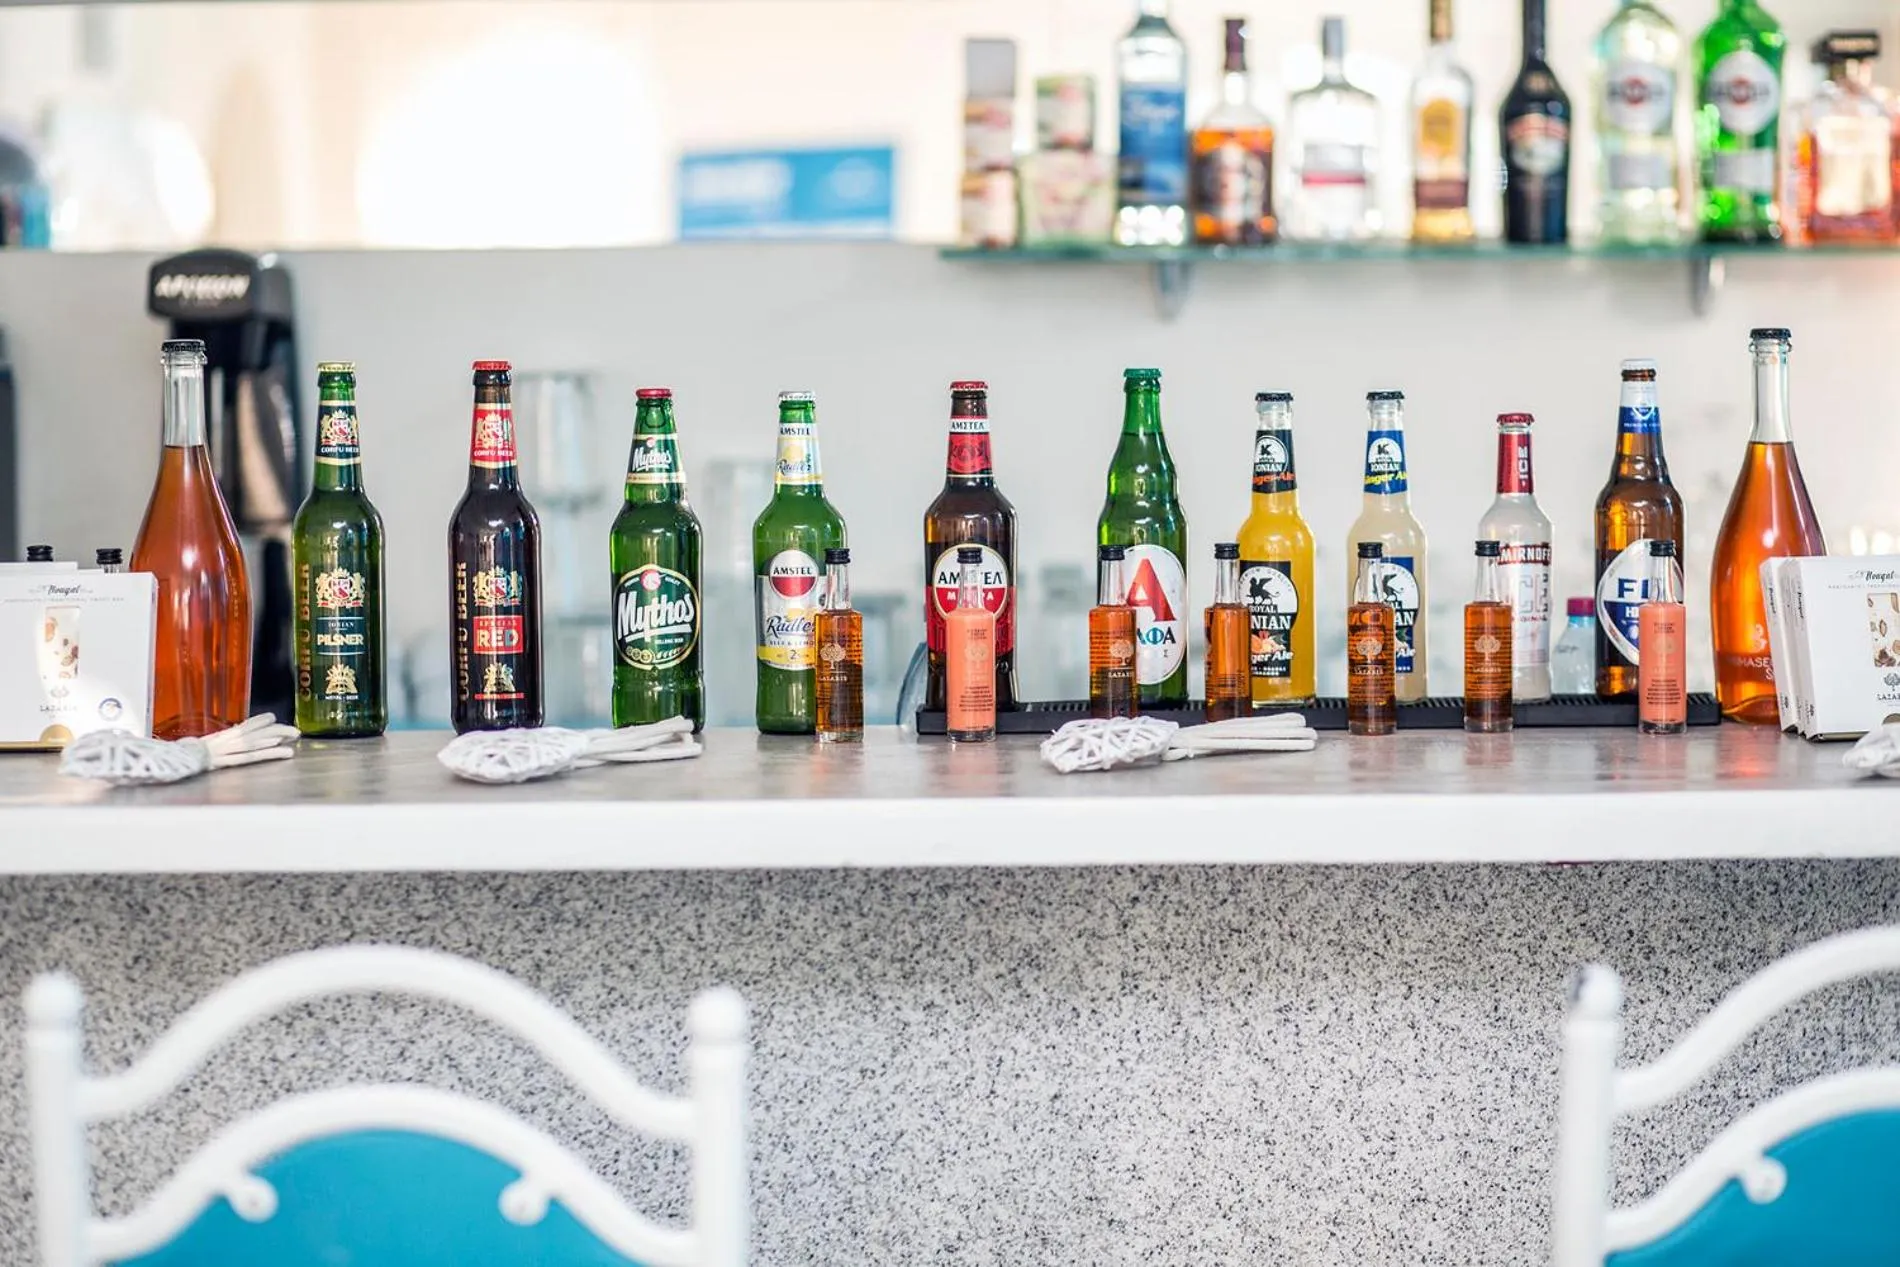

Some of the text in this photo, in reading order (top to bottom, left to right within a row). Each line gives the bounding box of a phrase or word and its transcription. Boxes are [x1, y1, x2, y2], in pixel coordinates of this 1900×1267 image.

[780, 427, 811, 436] AMSTEL
[951, 421, 986, 431] ΑΜΣΤΕΛ
[632, 447, 672, 472] Mythos
[1518, 446, 1529, 479] ICE
[773, 566, 813, 576] AMSTEL
[617, 591, 695, 643] Mythos
[1251, 615, 1292, 630] NIAN
[317, 633, 364, 646] PILSNER
[477, 629, 520, 648] RED
